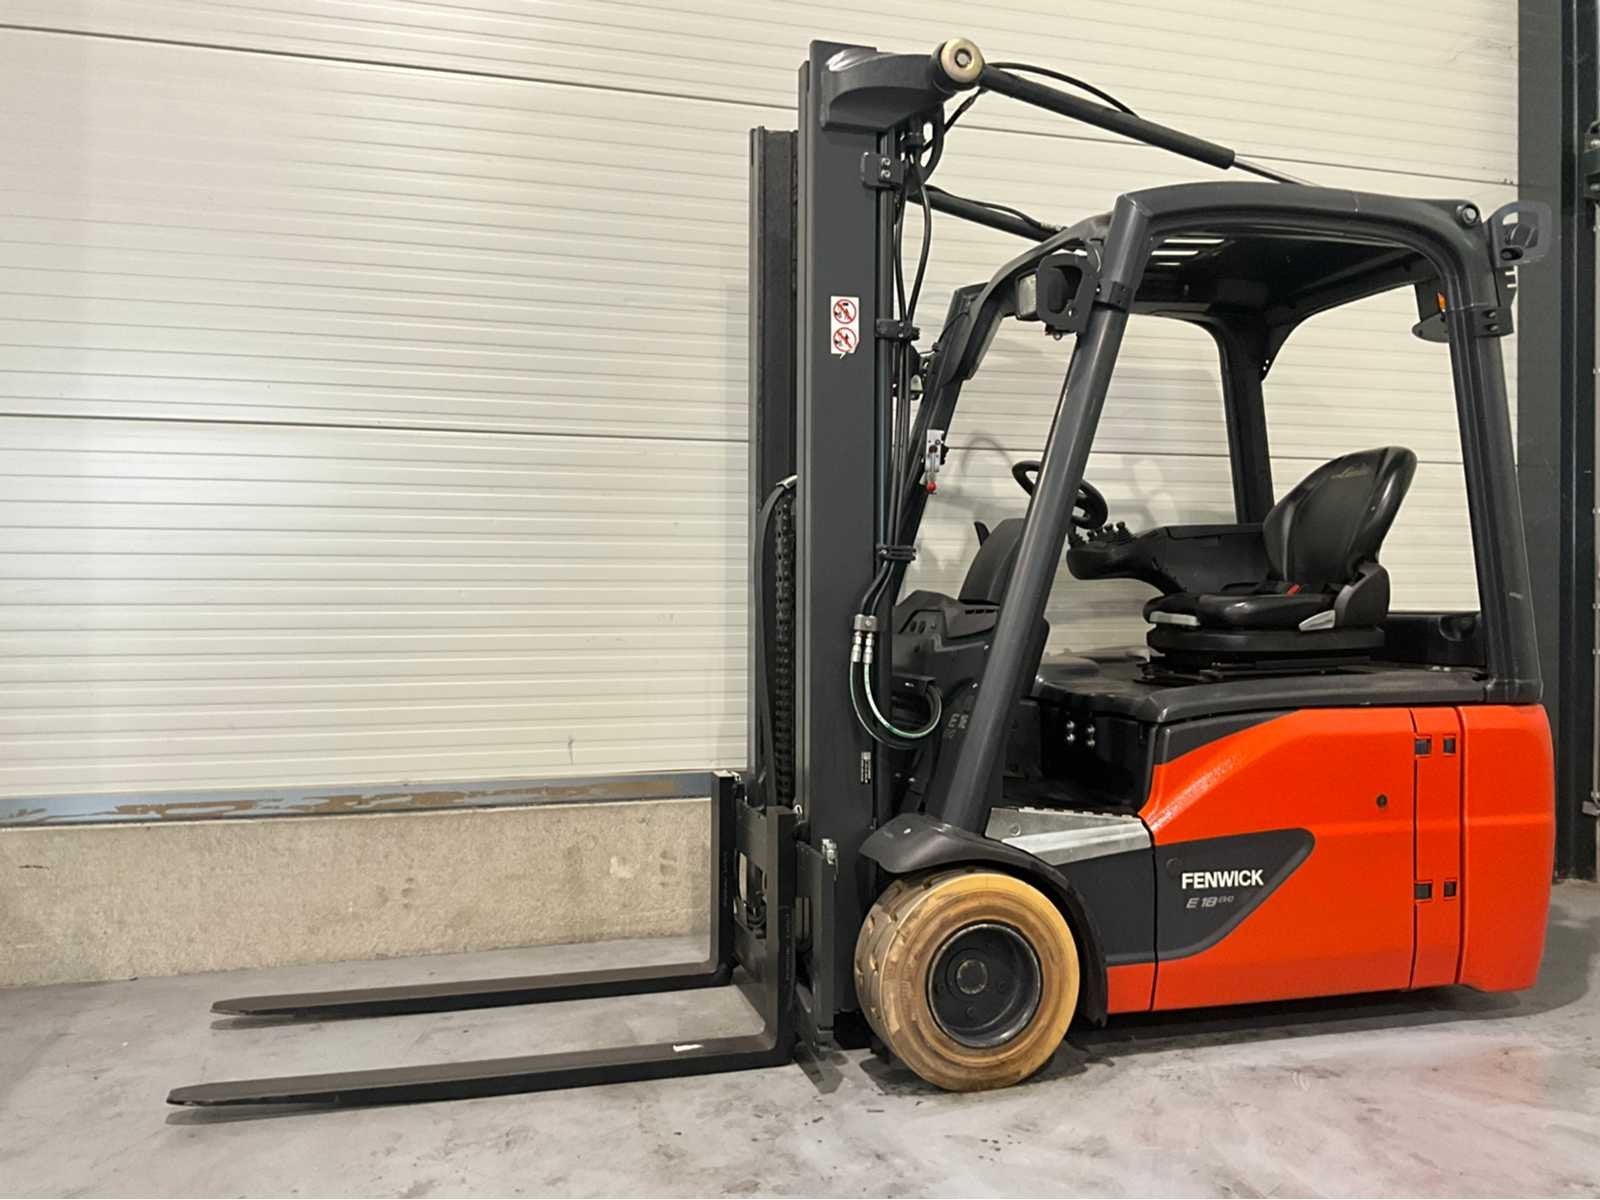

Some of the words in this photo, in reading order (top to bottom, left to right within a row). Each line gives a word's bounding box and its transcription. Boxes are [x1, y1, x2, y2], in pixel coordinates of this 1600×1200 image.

[1181, 869, 1264, 890] FENWICK
[1186, 897, 1200, 909] E
[1201, 896, 1218, 908] 18
